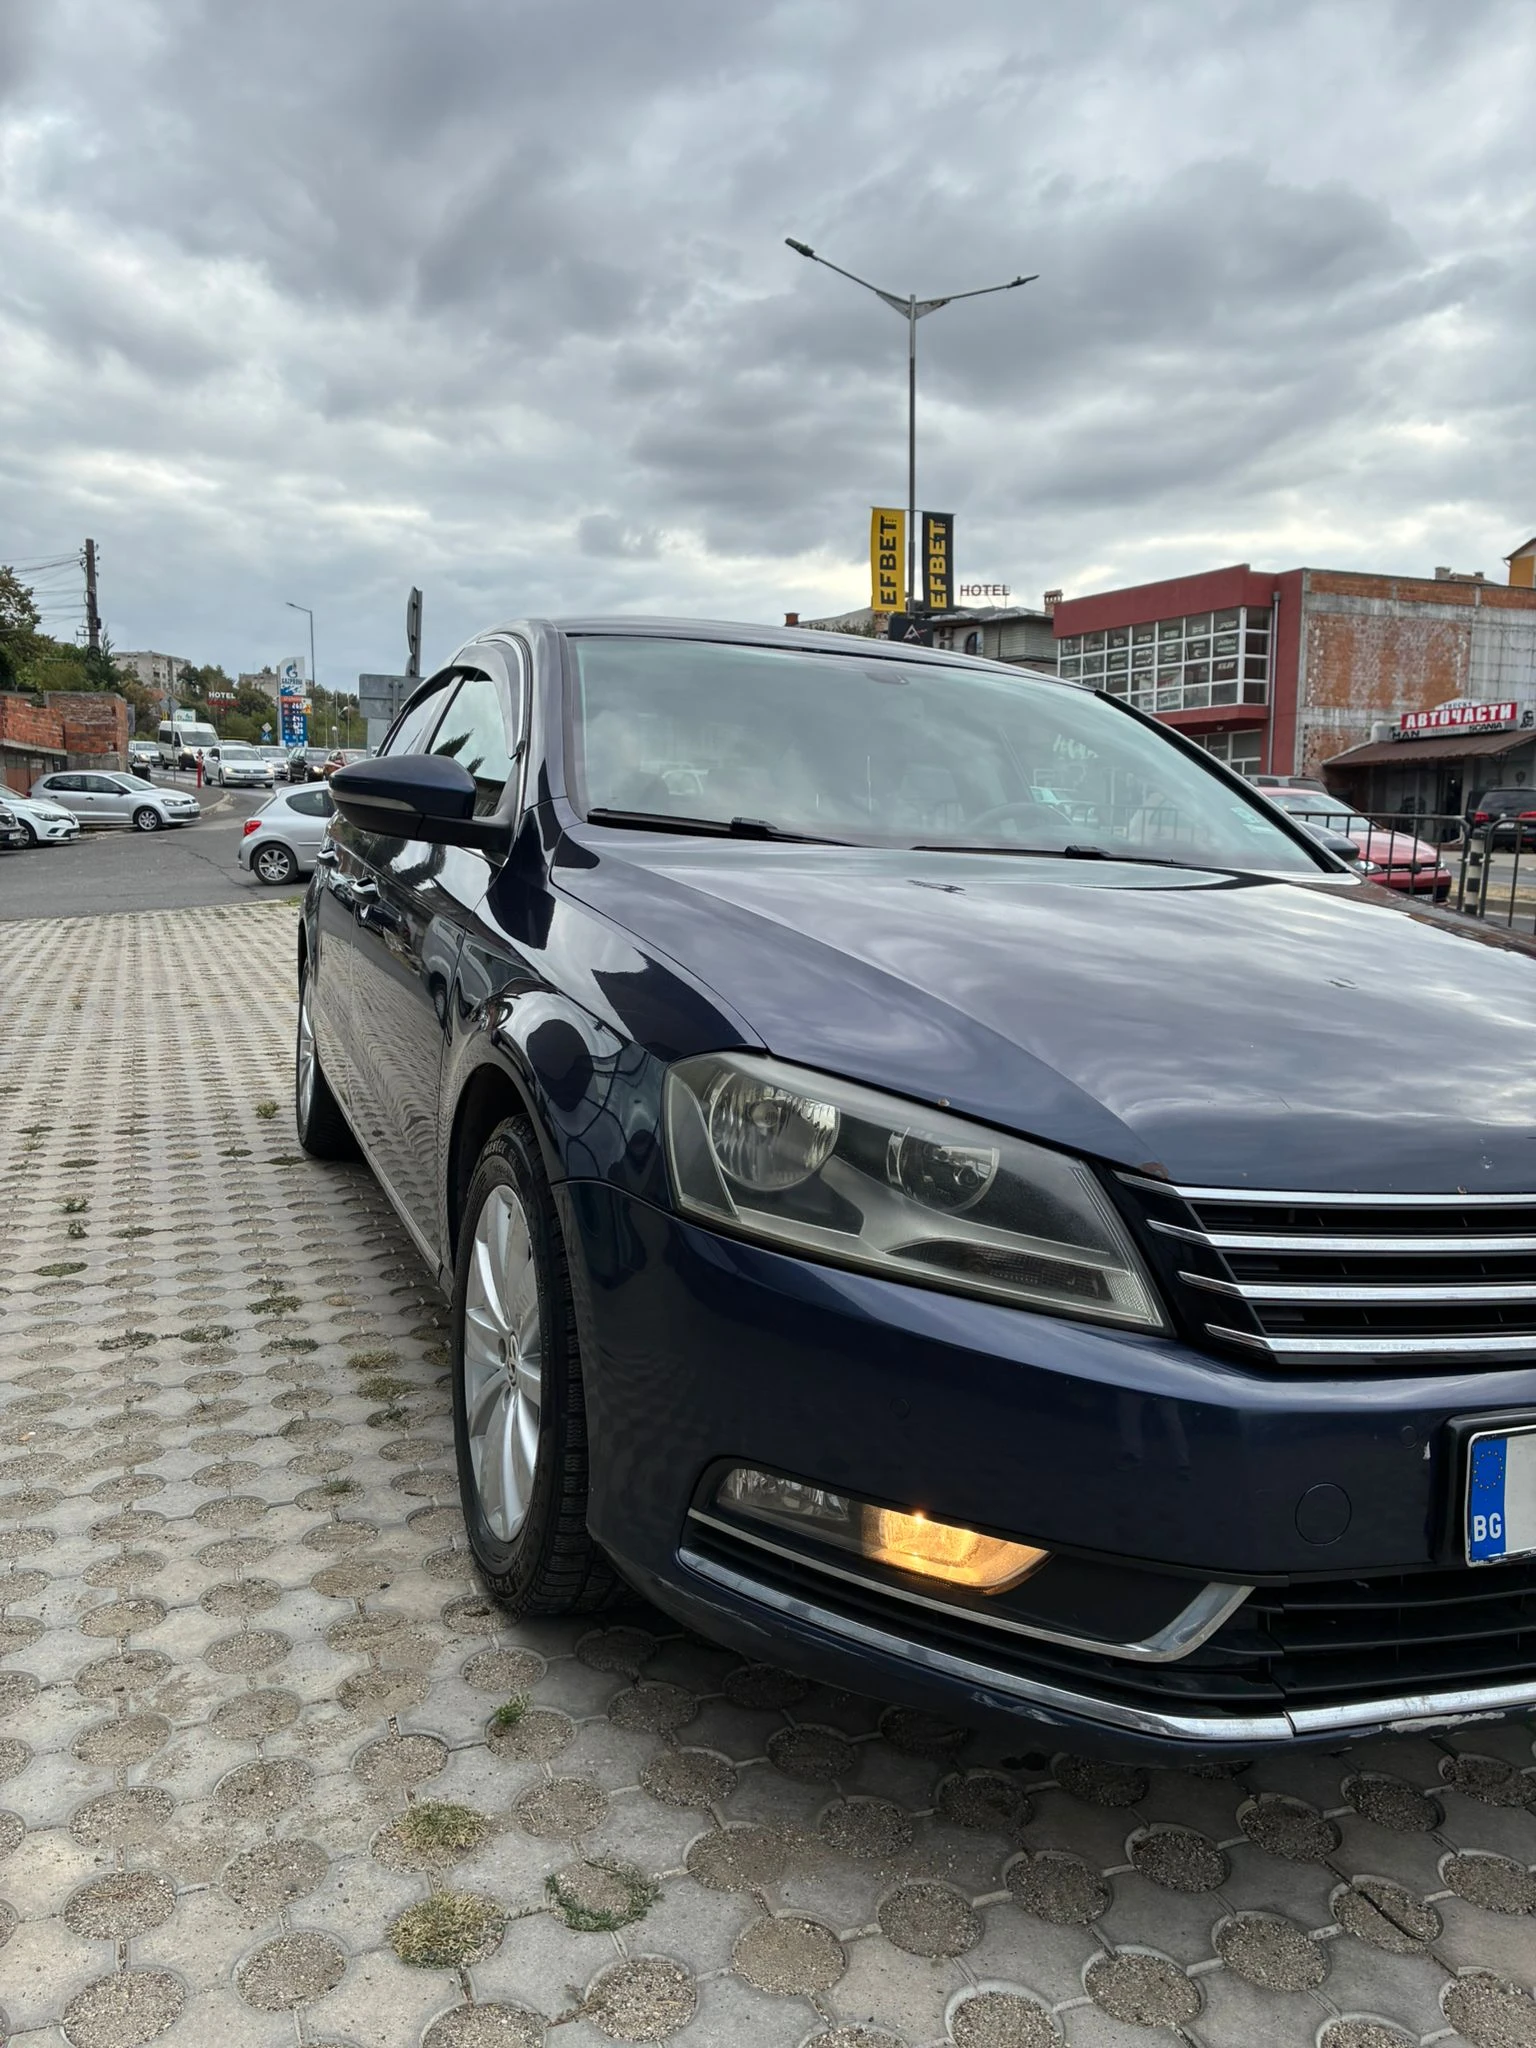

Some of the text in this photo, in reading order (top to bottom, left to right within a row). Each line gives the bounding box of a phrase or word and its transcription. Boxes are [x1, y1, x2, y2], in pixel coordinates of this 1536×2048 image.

[880, 515, 897, 605] EFBET
[929, 519, 946, 608] EFBET
[959, 584, 1011, 597] HOTEL
[208, 691, 236, 699] HOTEL
[1406, 704, 1512, 729] АВТОЧАСТИ
[1391, 729, 1420, 740] MAN
[1468, 721, 1503, 732] SCANIA
[1473, 1512, 1502, 1543] BG
